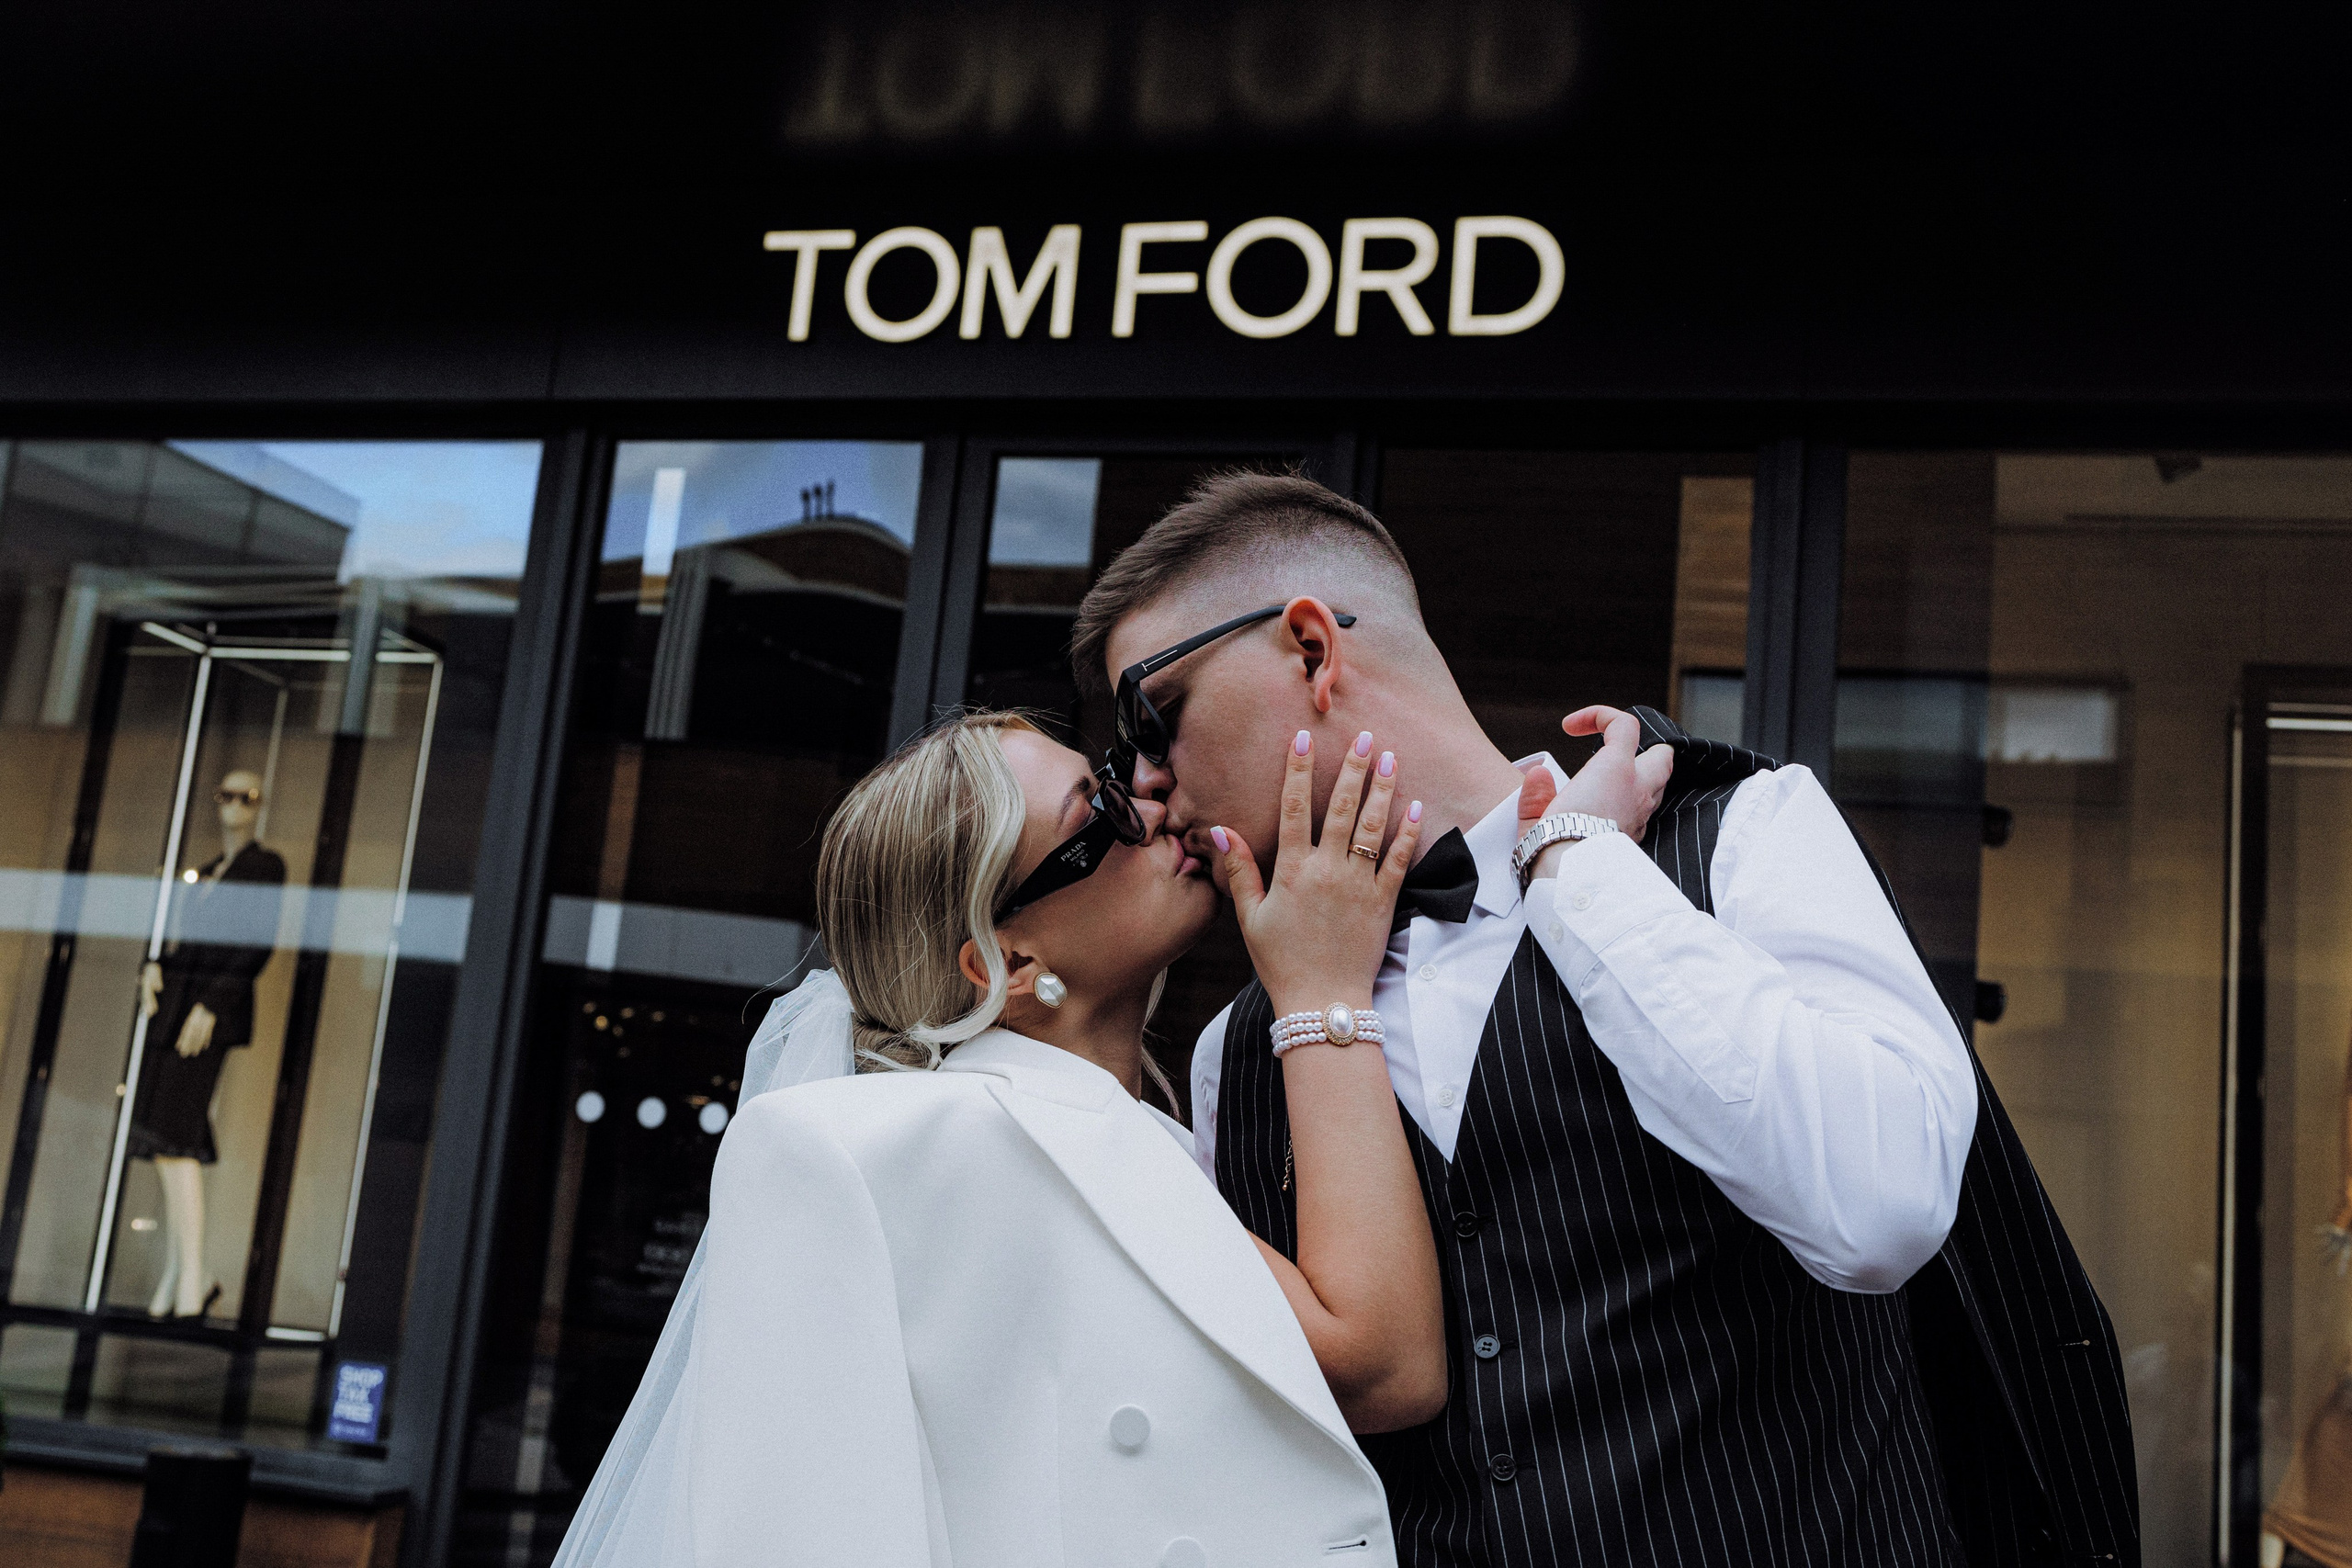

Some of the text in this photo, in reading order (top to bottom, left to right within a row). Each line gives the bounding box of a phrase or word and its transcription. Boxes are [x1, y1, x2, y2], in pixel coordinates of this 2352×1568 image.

[763, 215, 1566, 343] TOM FORD
[1060, 841, 1087, 862] PRADA
